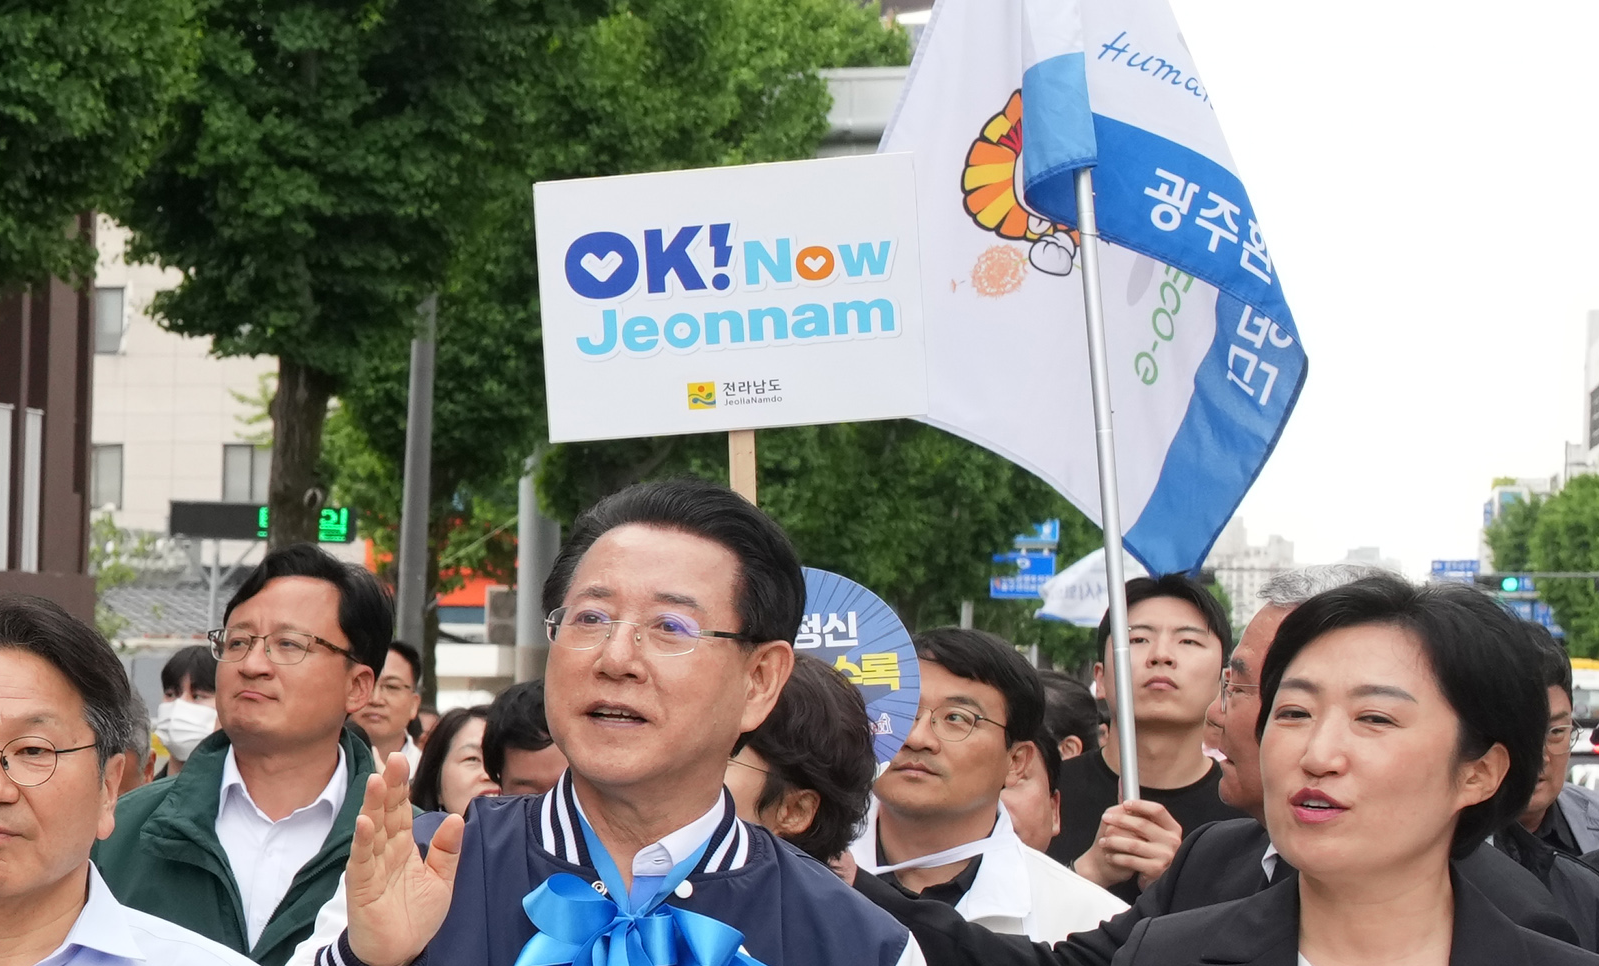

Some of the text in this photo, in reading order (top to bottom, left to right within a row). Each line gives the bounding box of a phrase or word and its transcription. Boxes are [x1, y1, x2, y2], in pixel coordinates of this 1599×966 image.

[564, 221, 733, 301] OK!
[575, 297, 896, 356] Jeonnam
[722, 378, 783, 397] 전라남도
[724, 394, 783, 407] JeollaNamdo
